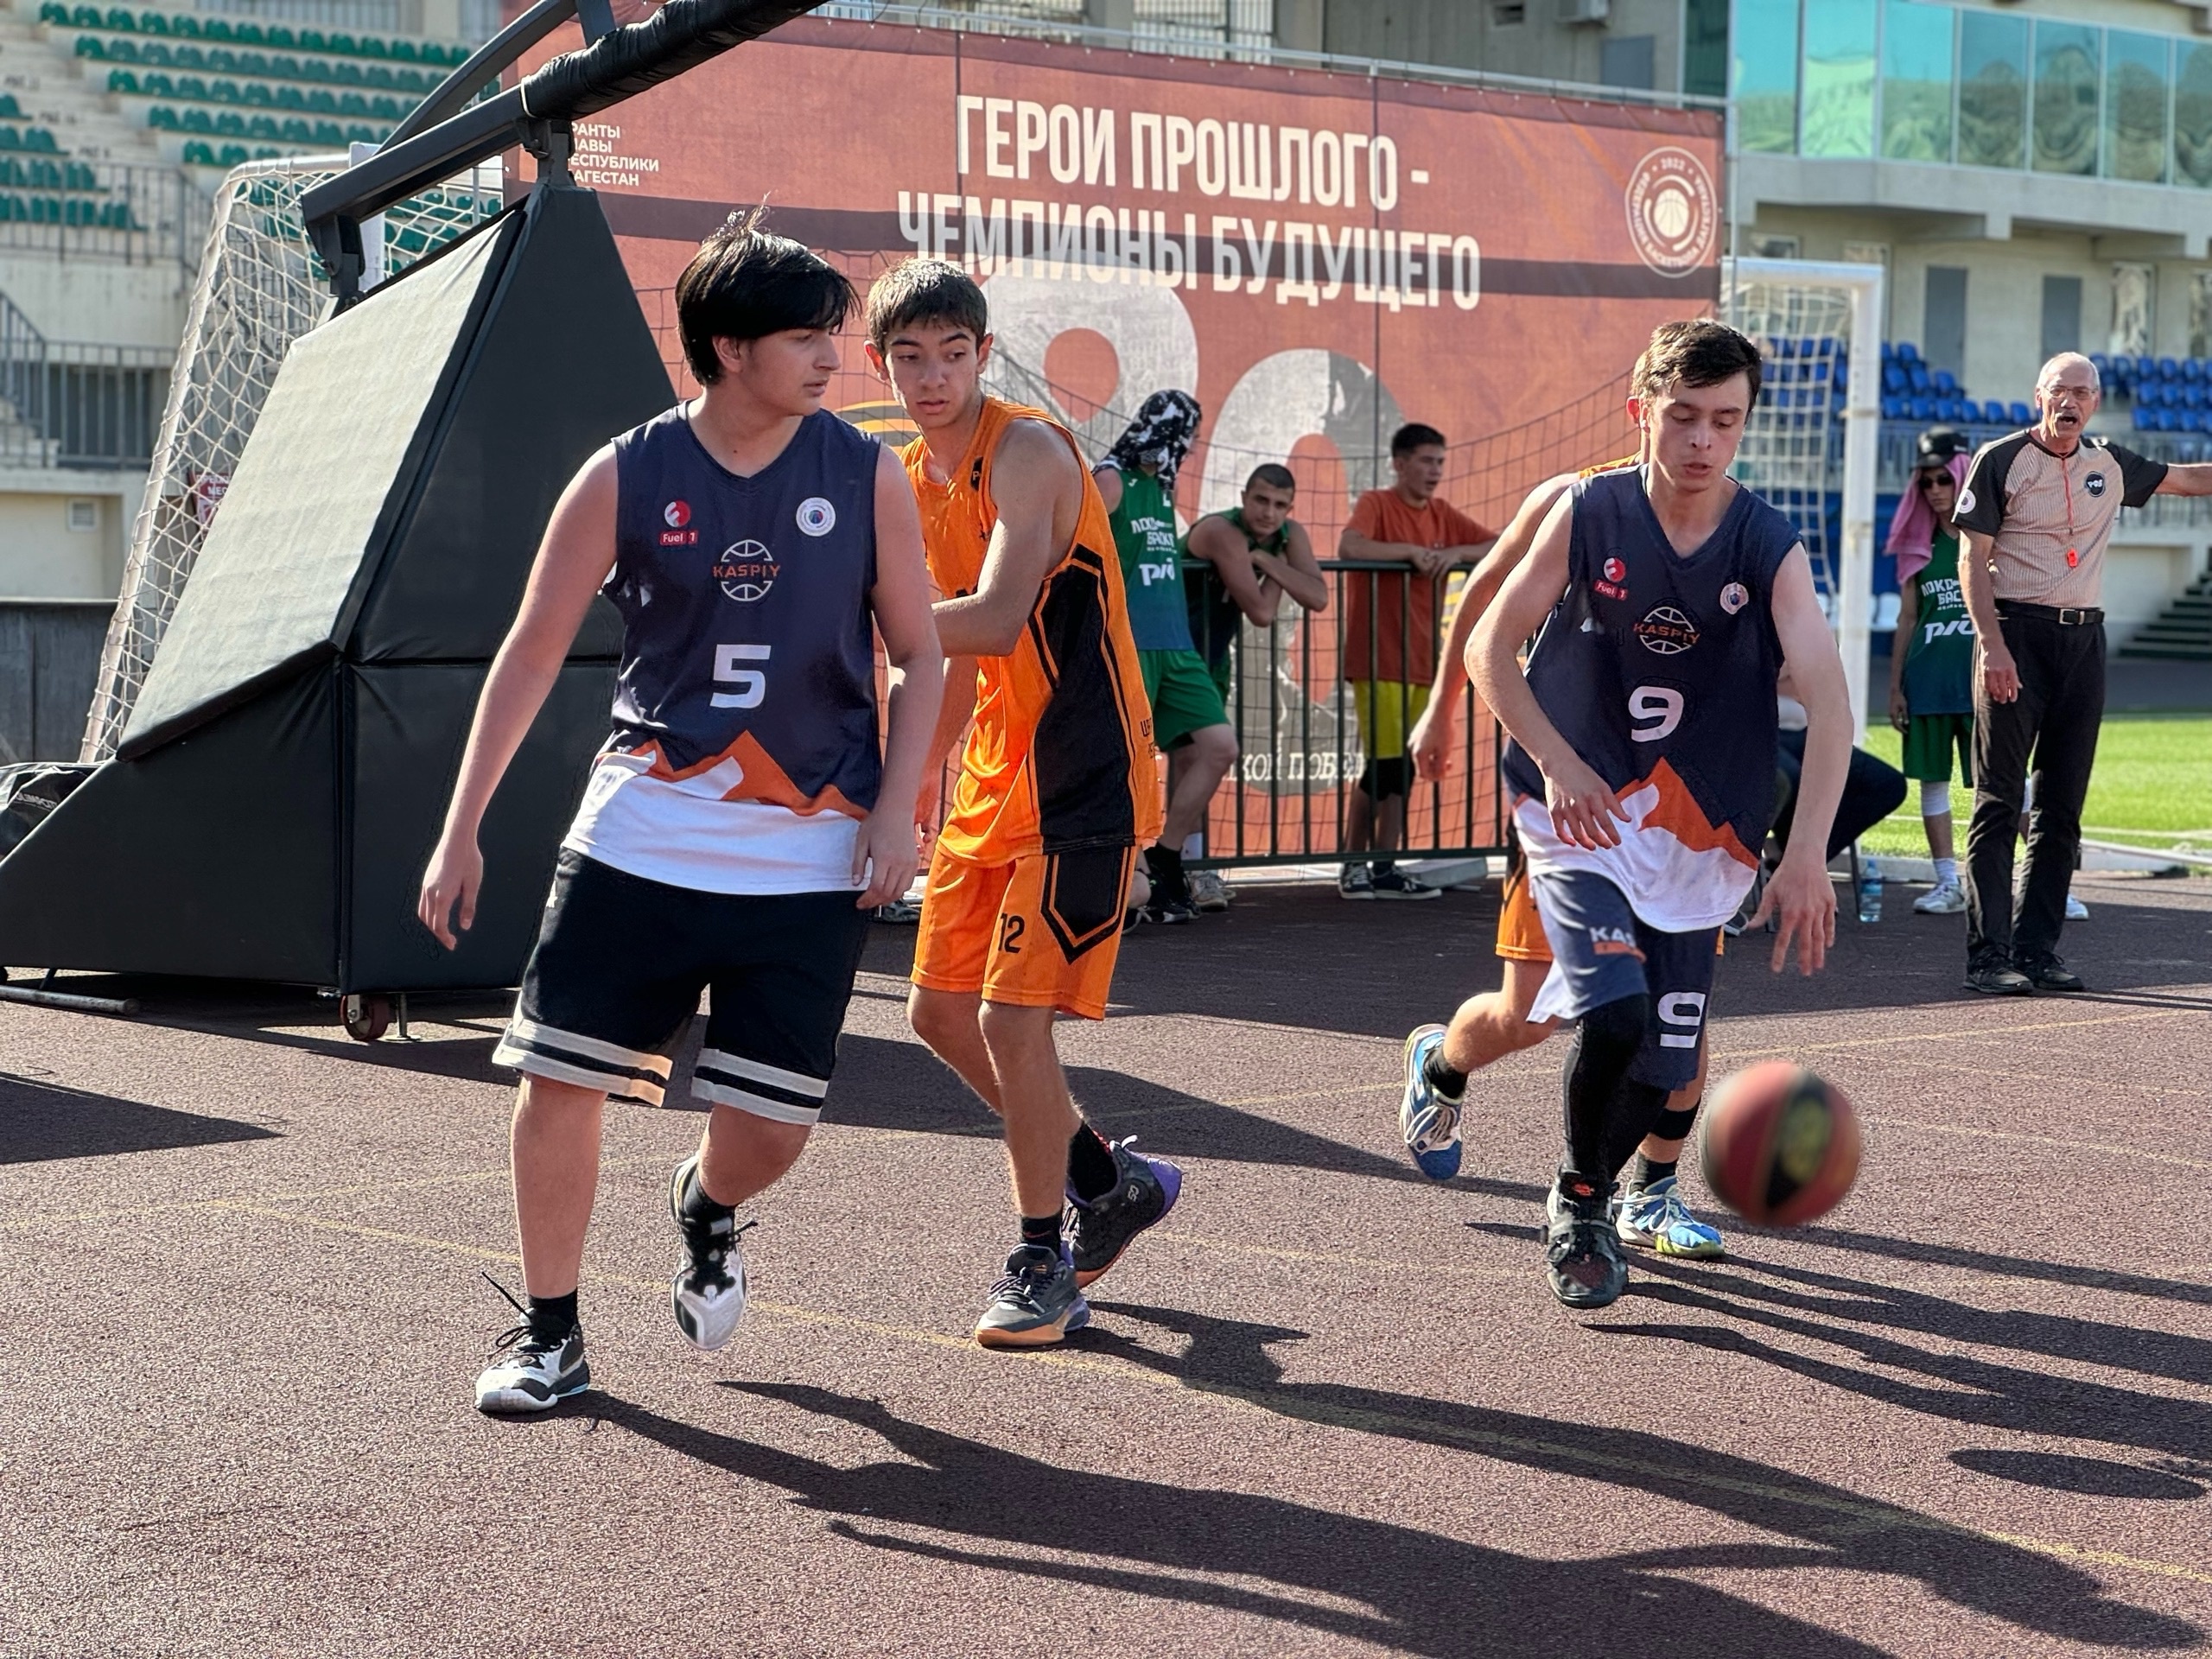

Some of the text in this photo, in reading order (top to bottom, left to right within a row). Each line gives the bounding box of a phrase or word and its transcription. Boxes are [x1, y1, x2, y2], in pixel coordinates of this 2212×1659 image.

[571, 122, 620, 138] РАНТЫ
[575, 137, 612, 153] АВЫ
[957, 94, 1116, 187] ГЕРОИ
[1130, 111, 1398, 212] ПРОШЛОГО
[569, 154, 658, 172] ЕСПУБЛИКИ
[574, 170, 639, 186] АГЕСТАН
[897, 190, 1480, 313] ЧЕМПИОНЫ БУДУЩЕГО
[663, 531, 696, 543] Fuel 1
[712, 563, 781, 578] KASPIY
[1632, 622, 1701, 645] KASPIY
[709, 643, 772, 709] 5
[1628, 685, 1685, 743] 9
[997, 912, 1026, 954] 12
